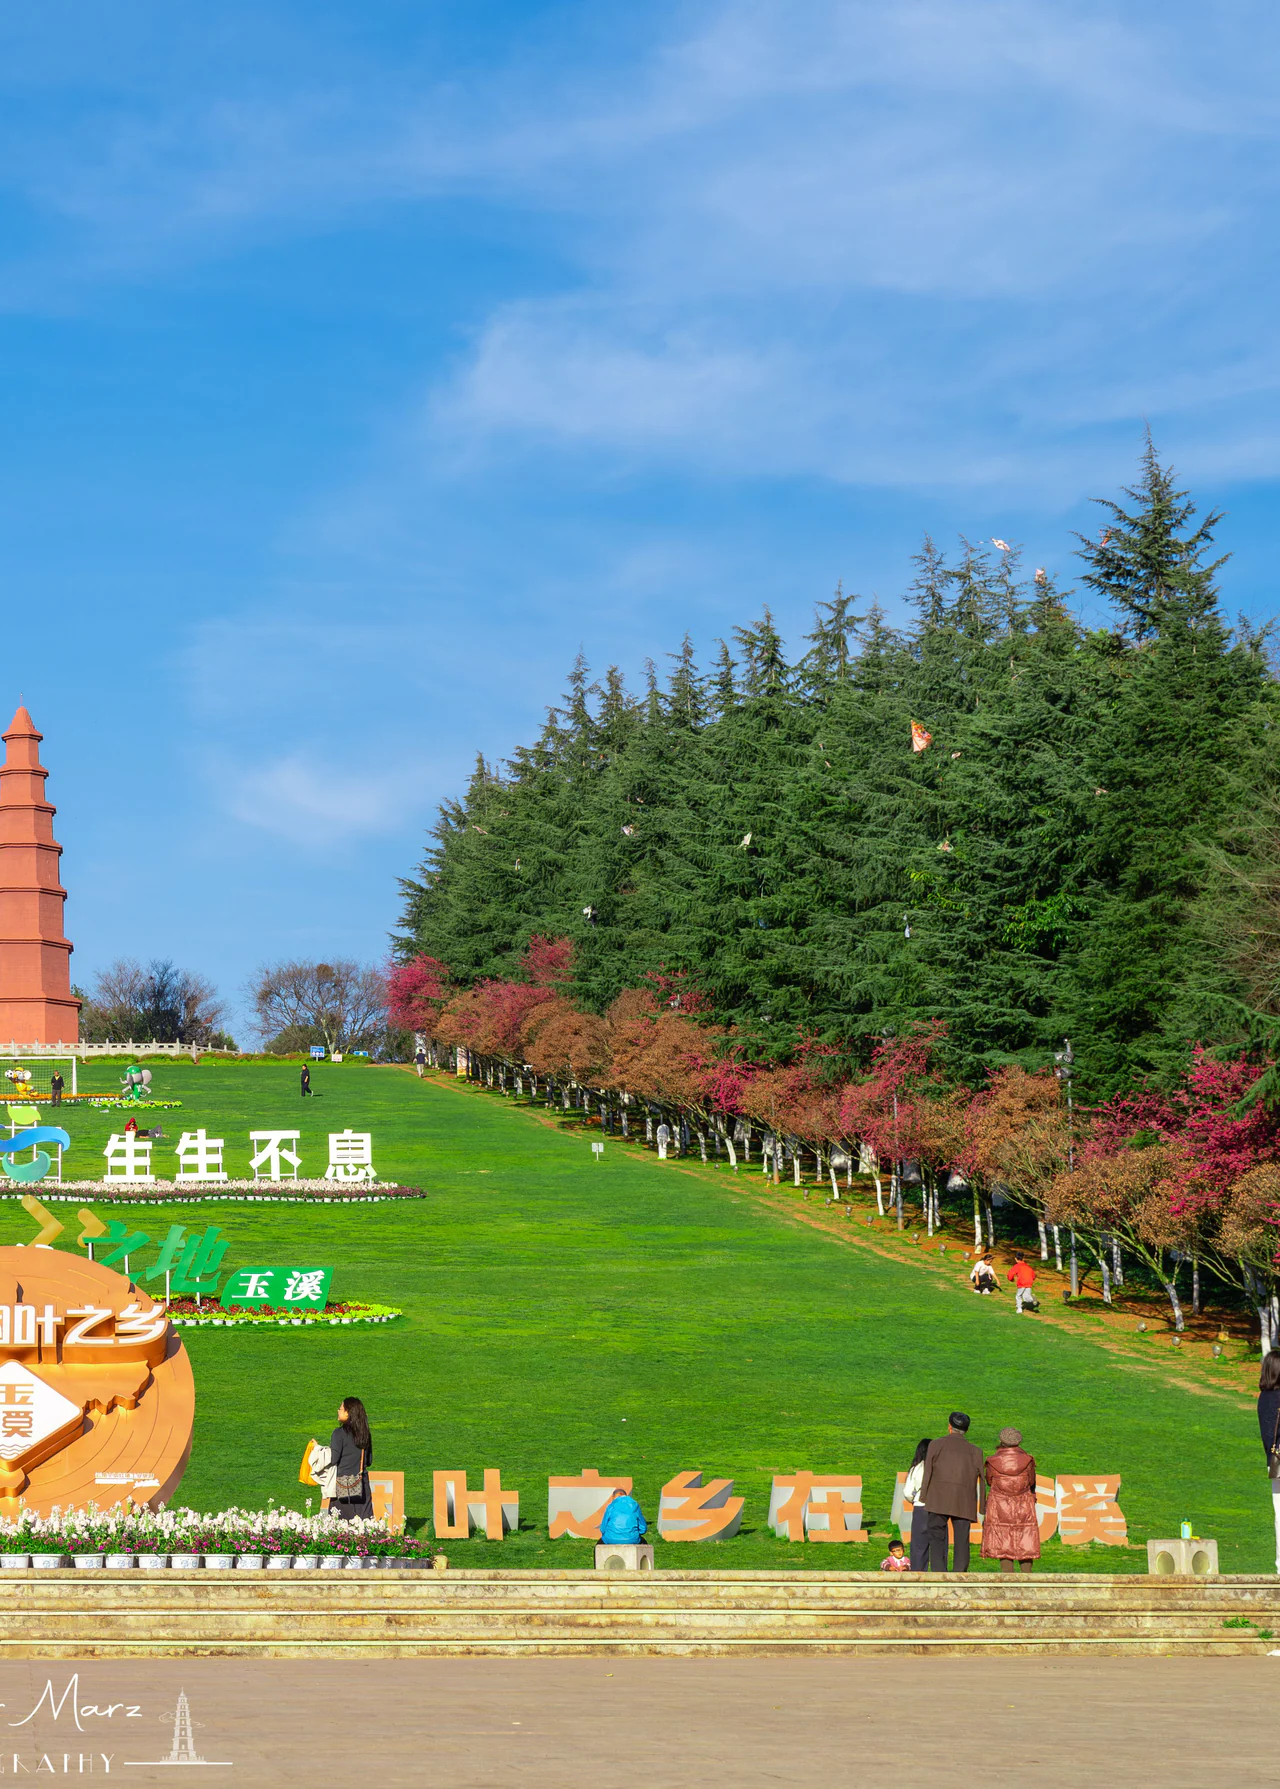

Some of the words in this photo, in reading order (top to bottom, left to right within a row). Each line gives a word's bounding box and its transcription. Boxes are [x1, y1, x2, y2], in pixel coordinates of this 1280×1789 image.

[103, 1129, 377, 1183] 生生不息
[231, 1270, 324, 1301] 玉溪
[320, 1469, 1128, 1546] 叶之乡在溪
